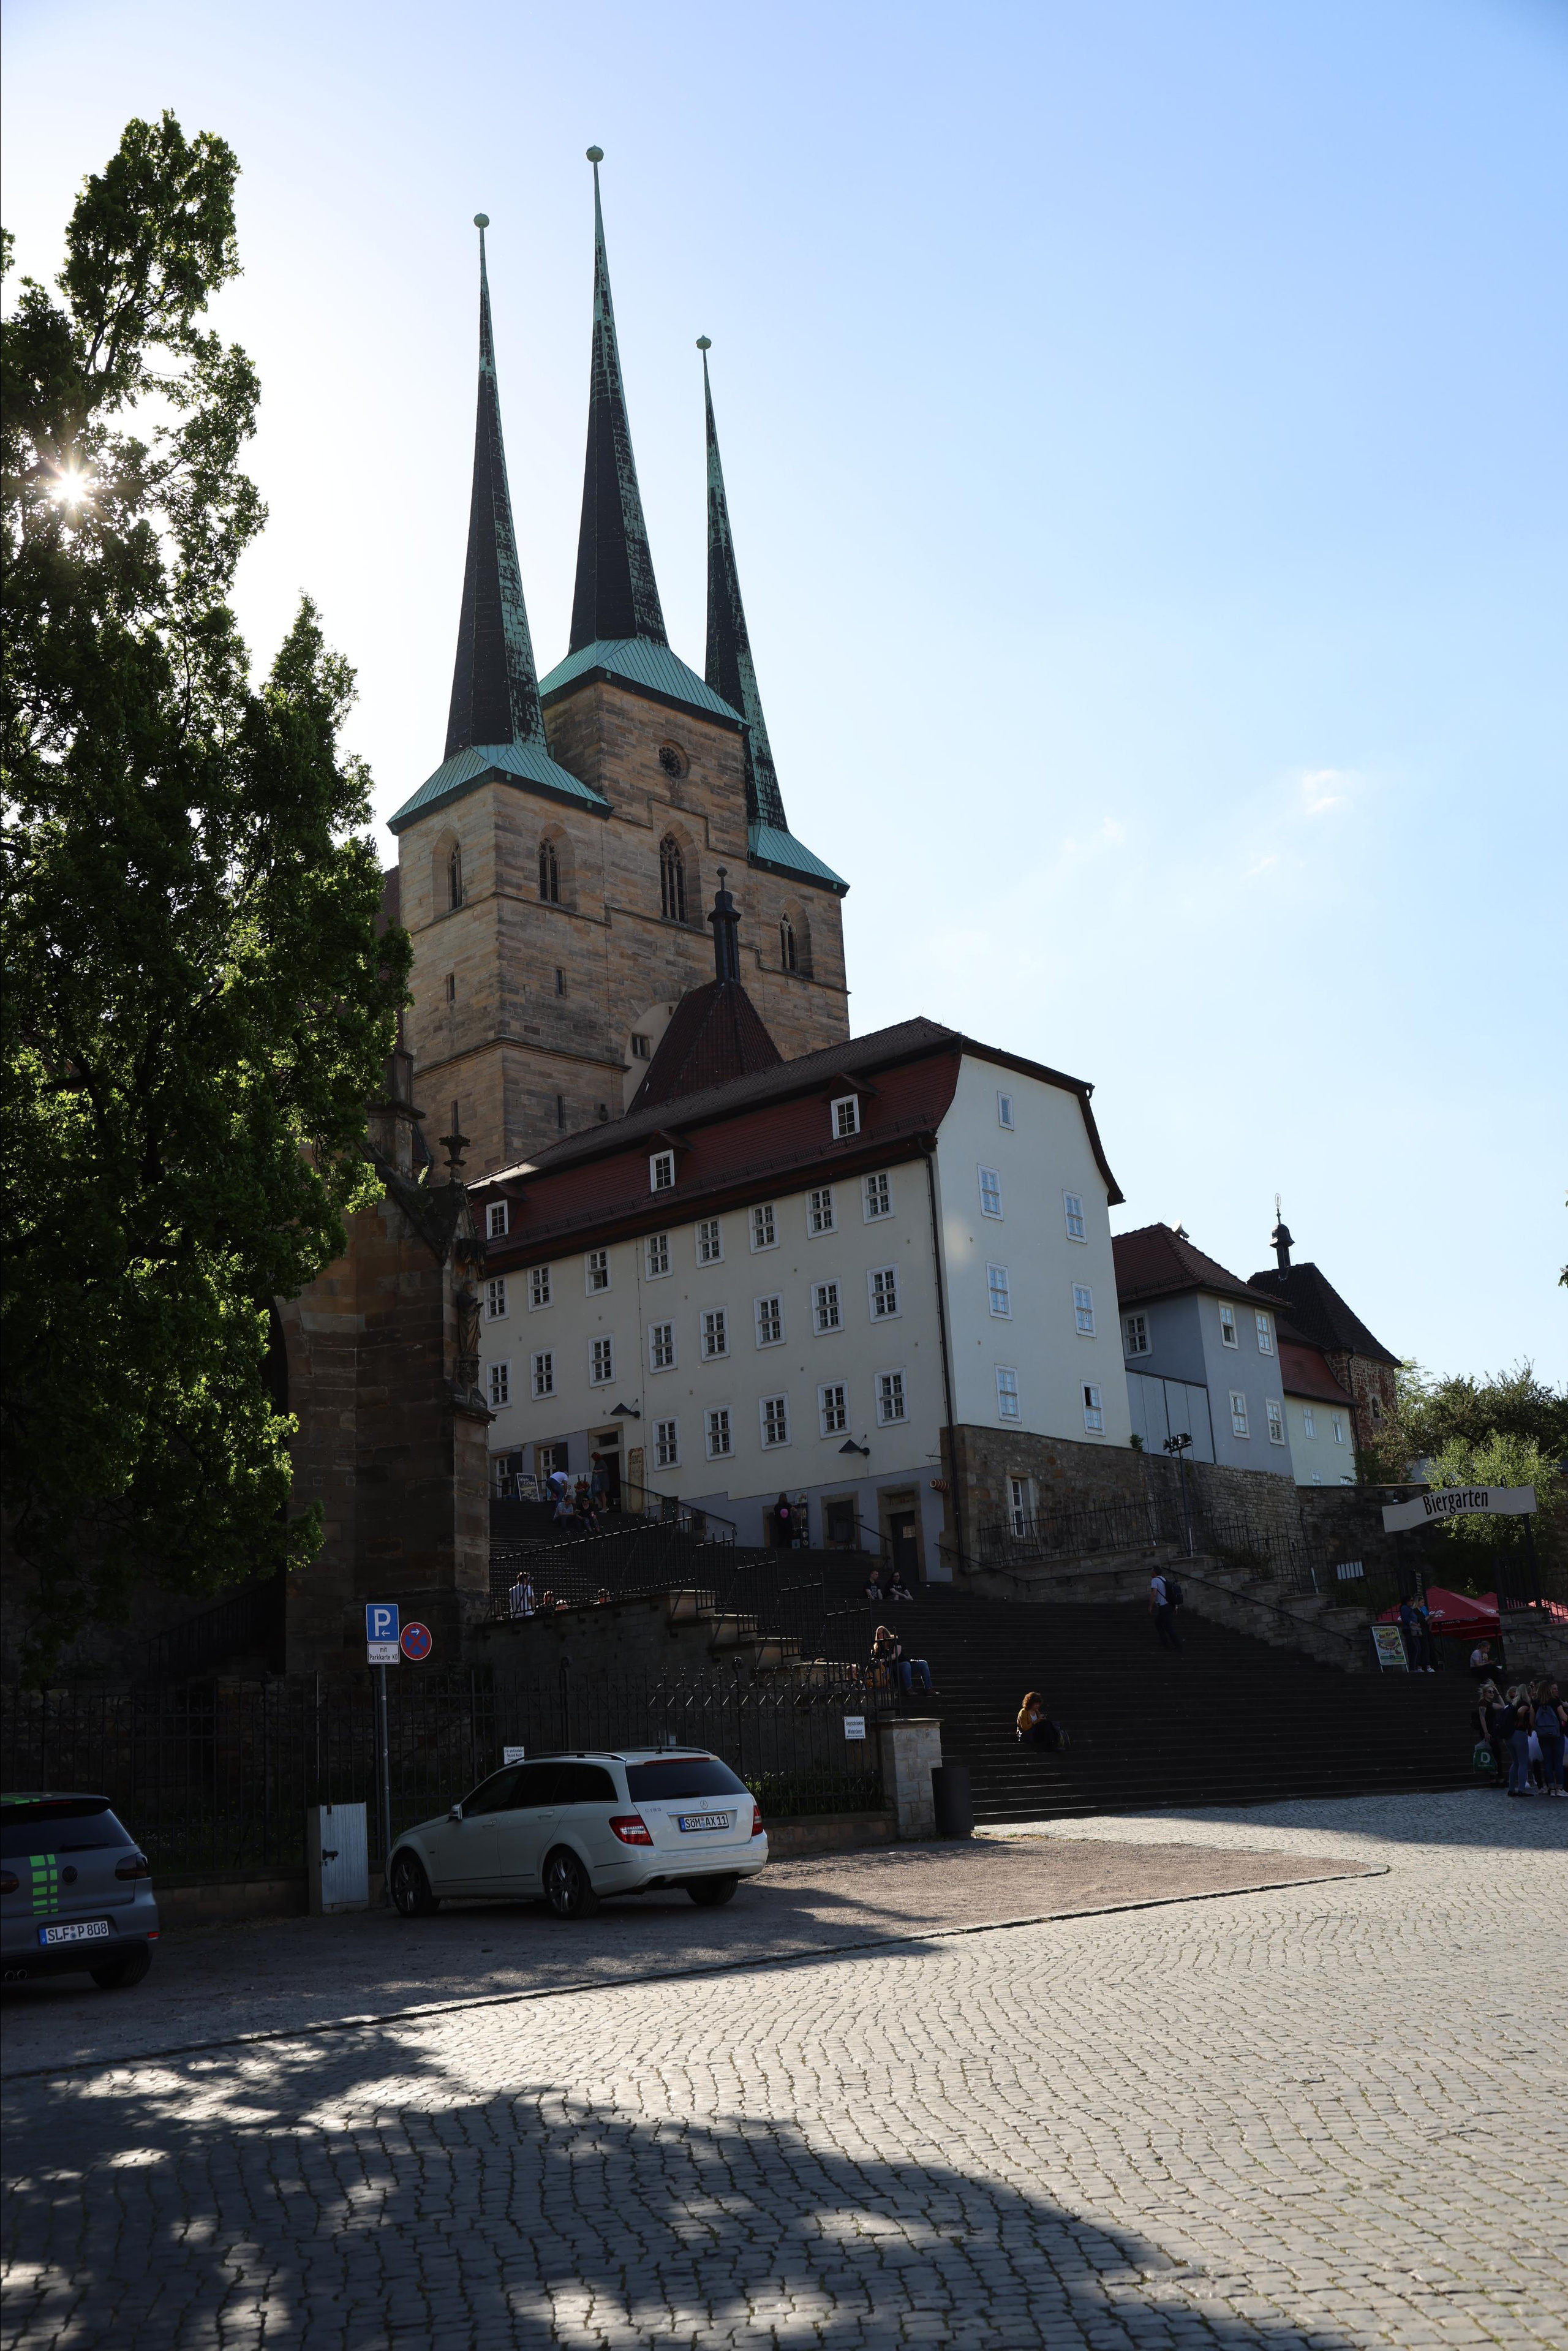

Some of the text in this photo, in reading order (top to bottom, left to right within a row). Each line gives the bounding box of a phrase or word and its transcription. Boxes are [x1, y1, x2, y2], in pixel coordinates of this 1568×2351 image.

[1422, 1490, 1488, 1515] Biergarten
[374, 1609, 391, 1637] P
[706, 1816, 716, 1827] AX
[717, 1816, 727, 1825] 11
[48, 1927, 69, 1941] SLF
[77, 1925, 85, 1938] P
[87, 1922, 107, 1936] 808
